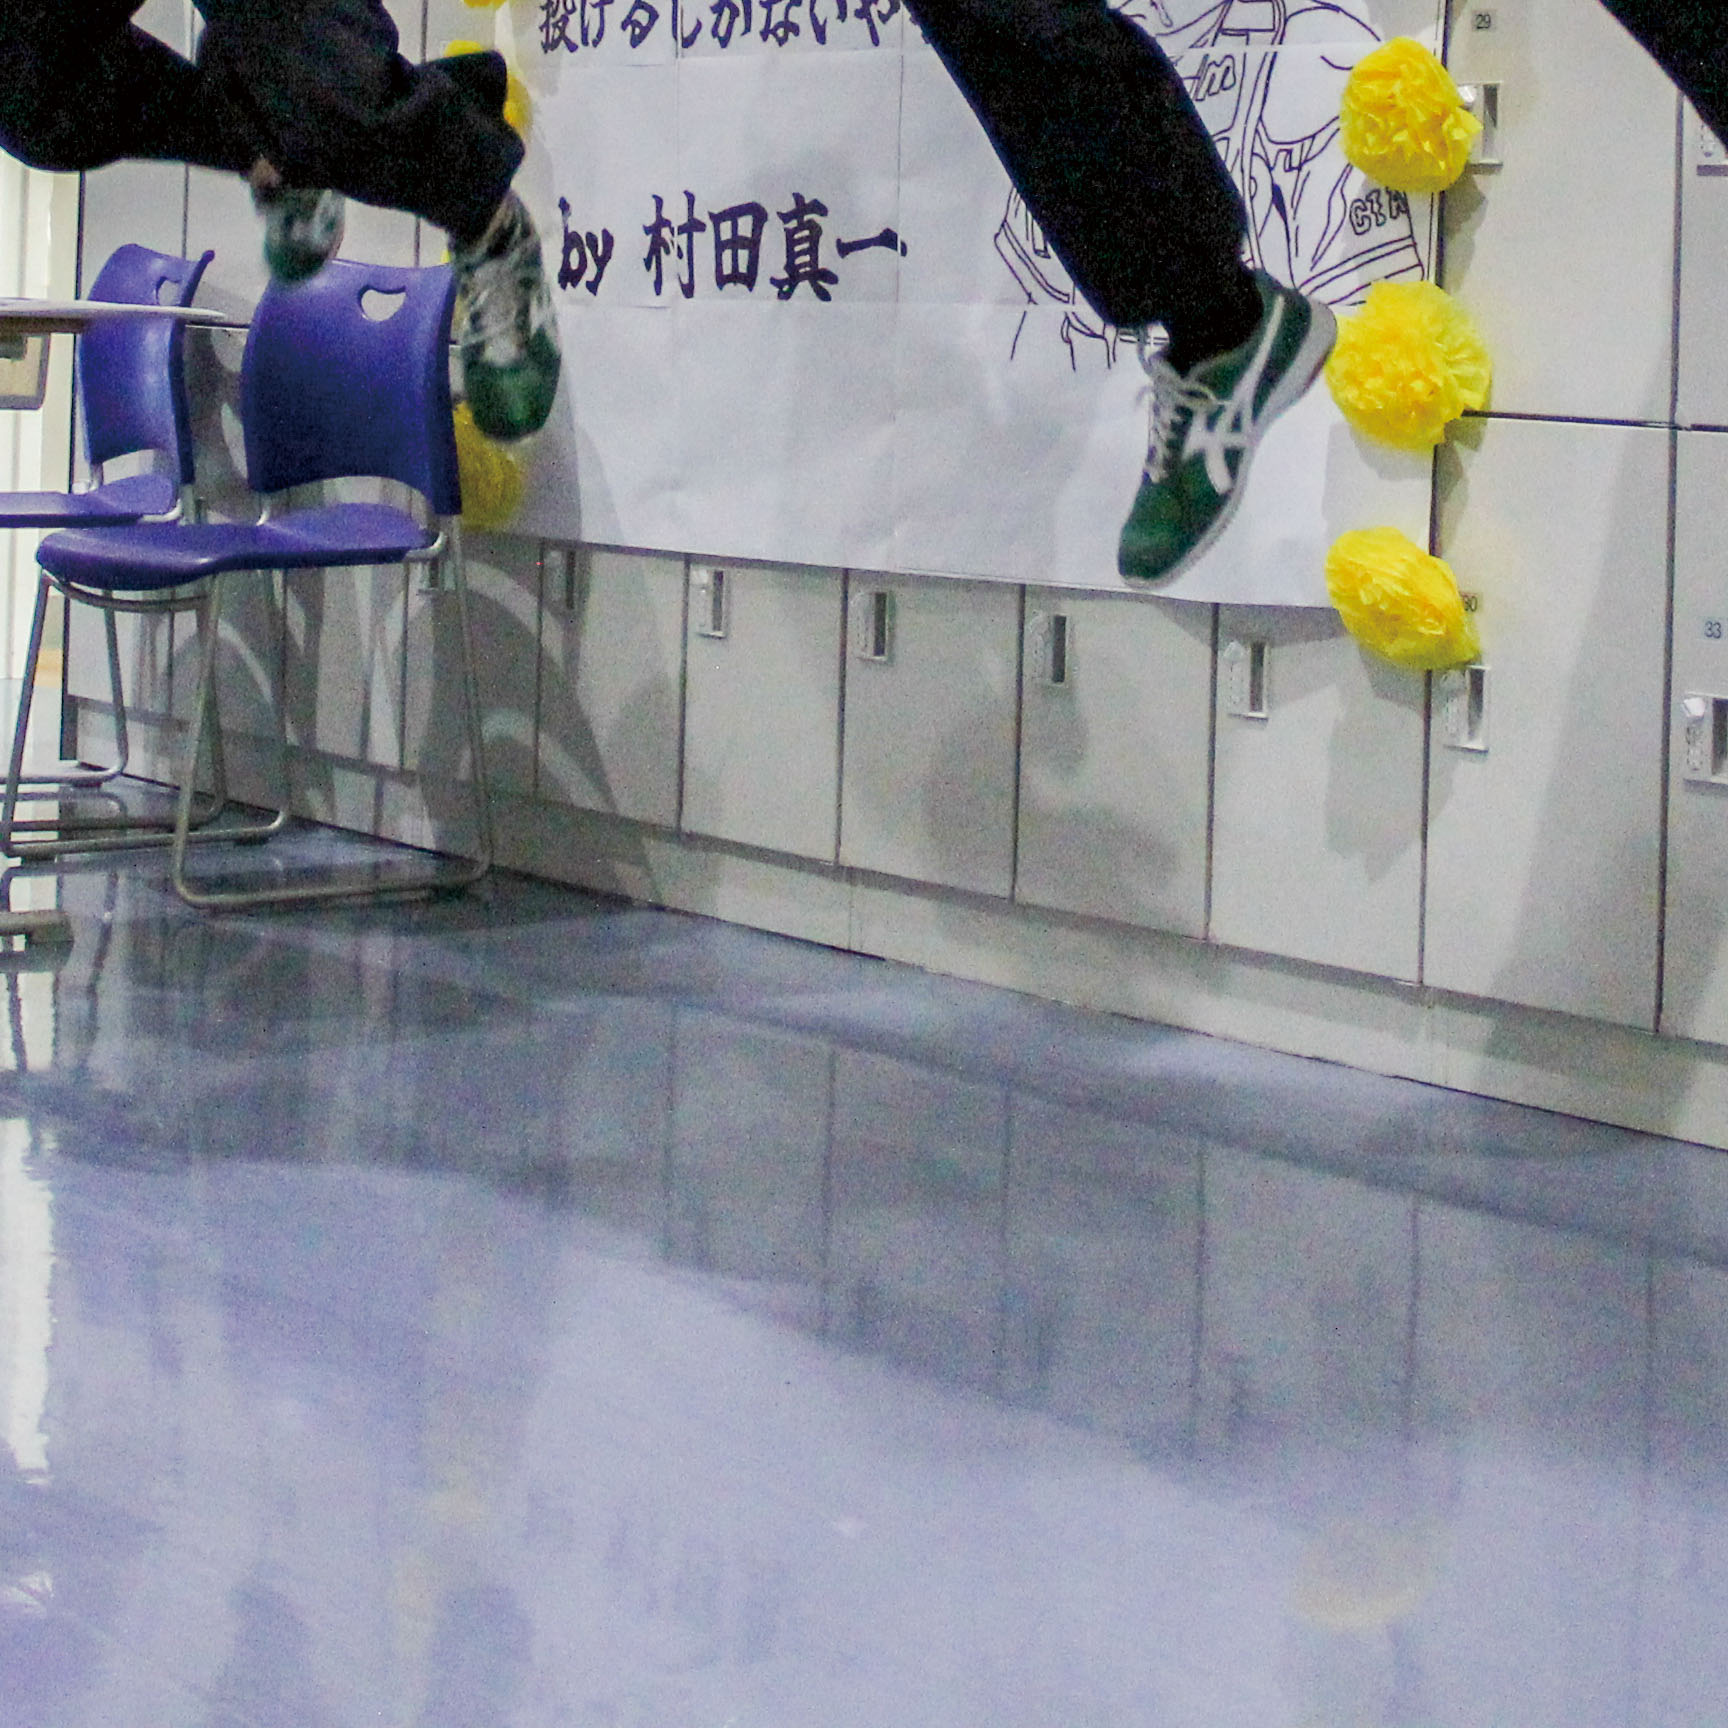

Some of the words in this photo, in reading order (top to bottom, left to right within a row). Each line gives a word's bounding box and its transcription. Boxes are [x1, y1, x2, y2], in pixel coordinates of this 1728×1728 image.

[1475, 13, 1492, 31] 29
[557, 196, 615, 297] by
[642, 189, 908, 302] 村田真一
[1705, 620, 1722, 640] 33
